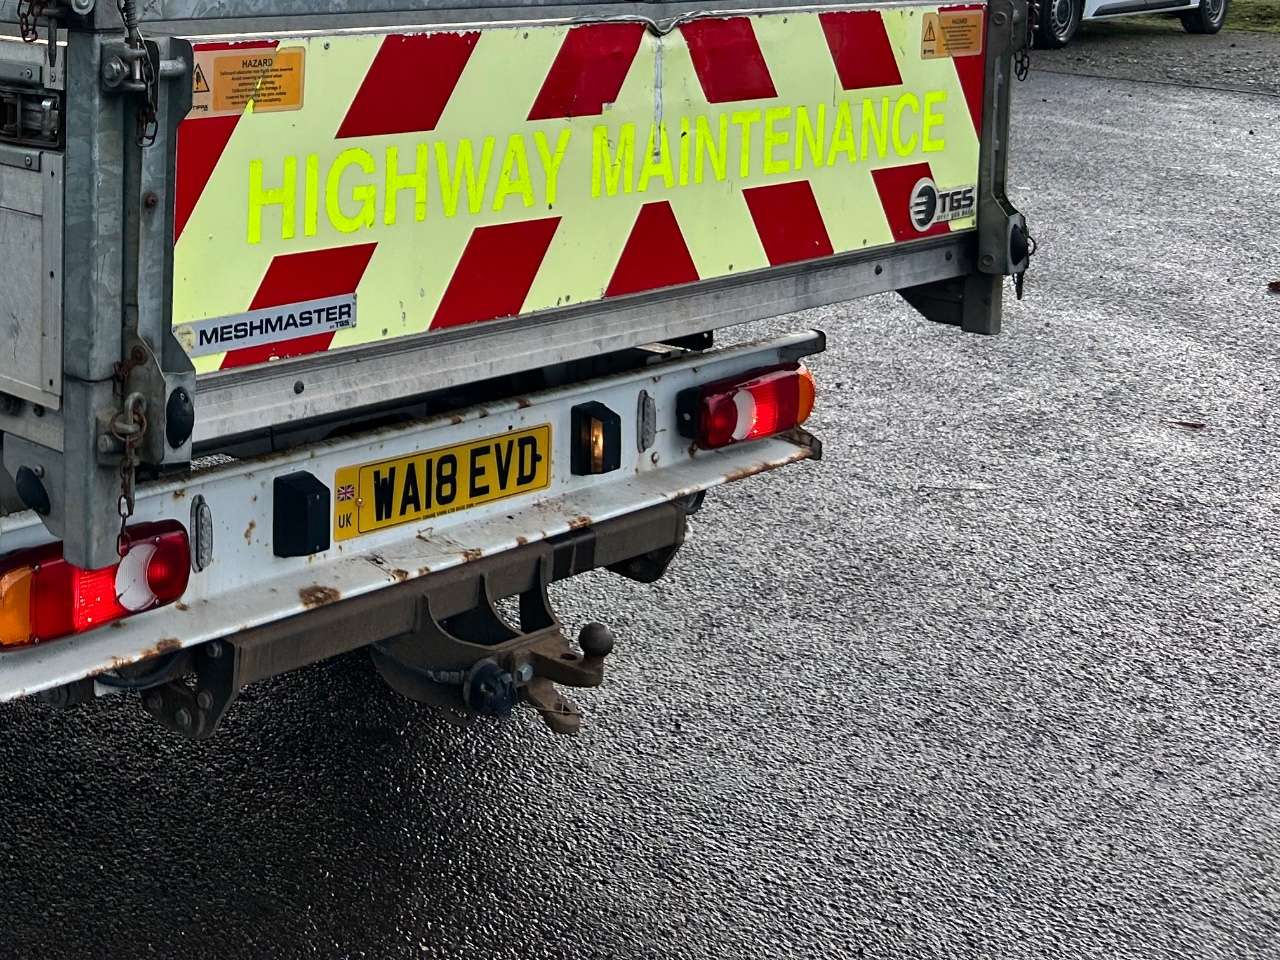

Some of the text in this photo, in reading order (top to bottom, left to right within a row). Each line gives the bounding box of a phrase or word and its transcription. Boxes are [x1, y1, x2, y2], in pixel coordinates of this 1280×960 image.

[241, 58, 274, 69] HAZARD
[248, 90, 949, 244] HIGHWAY MAINTENANCE
[938, 188, 974, 213] TGS
[199, 303, 352, 346] MESHMASTER
[373, 435, 539, 522] WA18 EVD
[337, 511, 352, 529] UK
